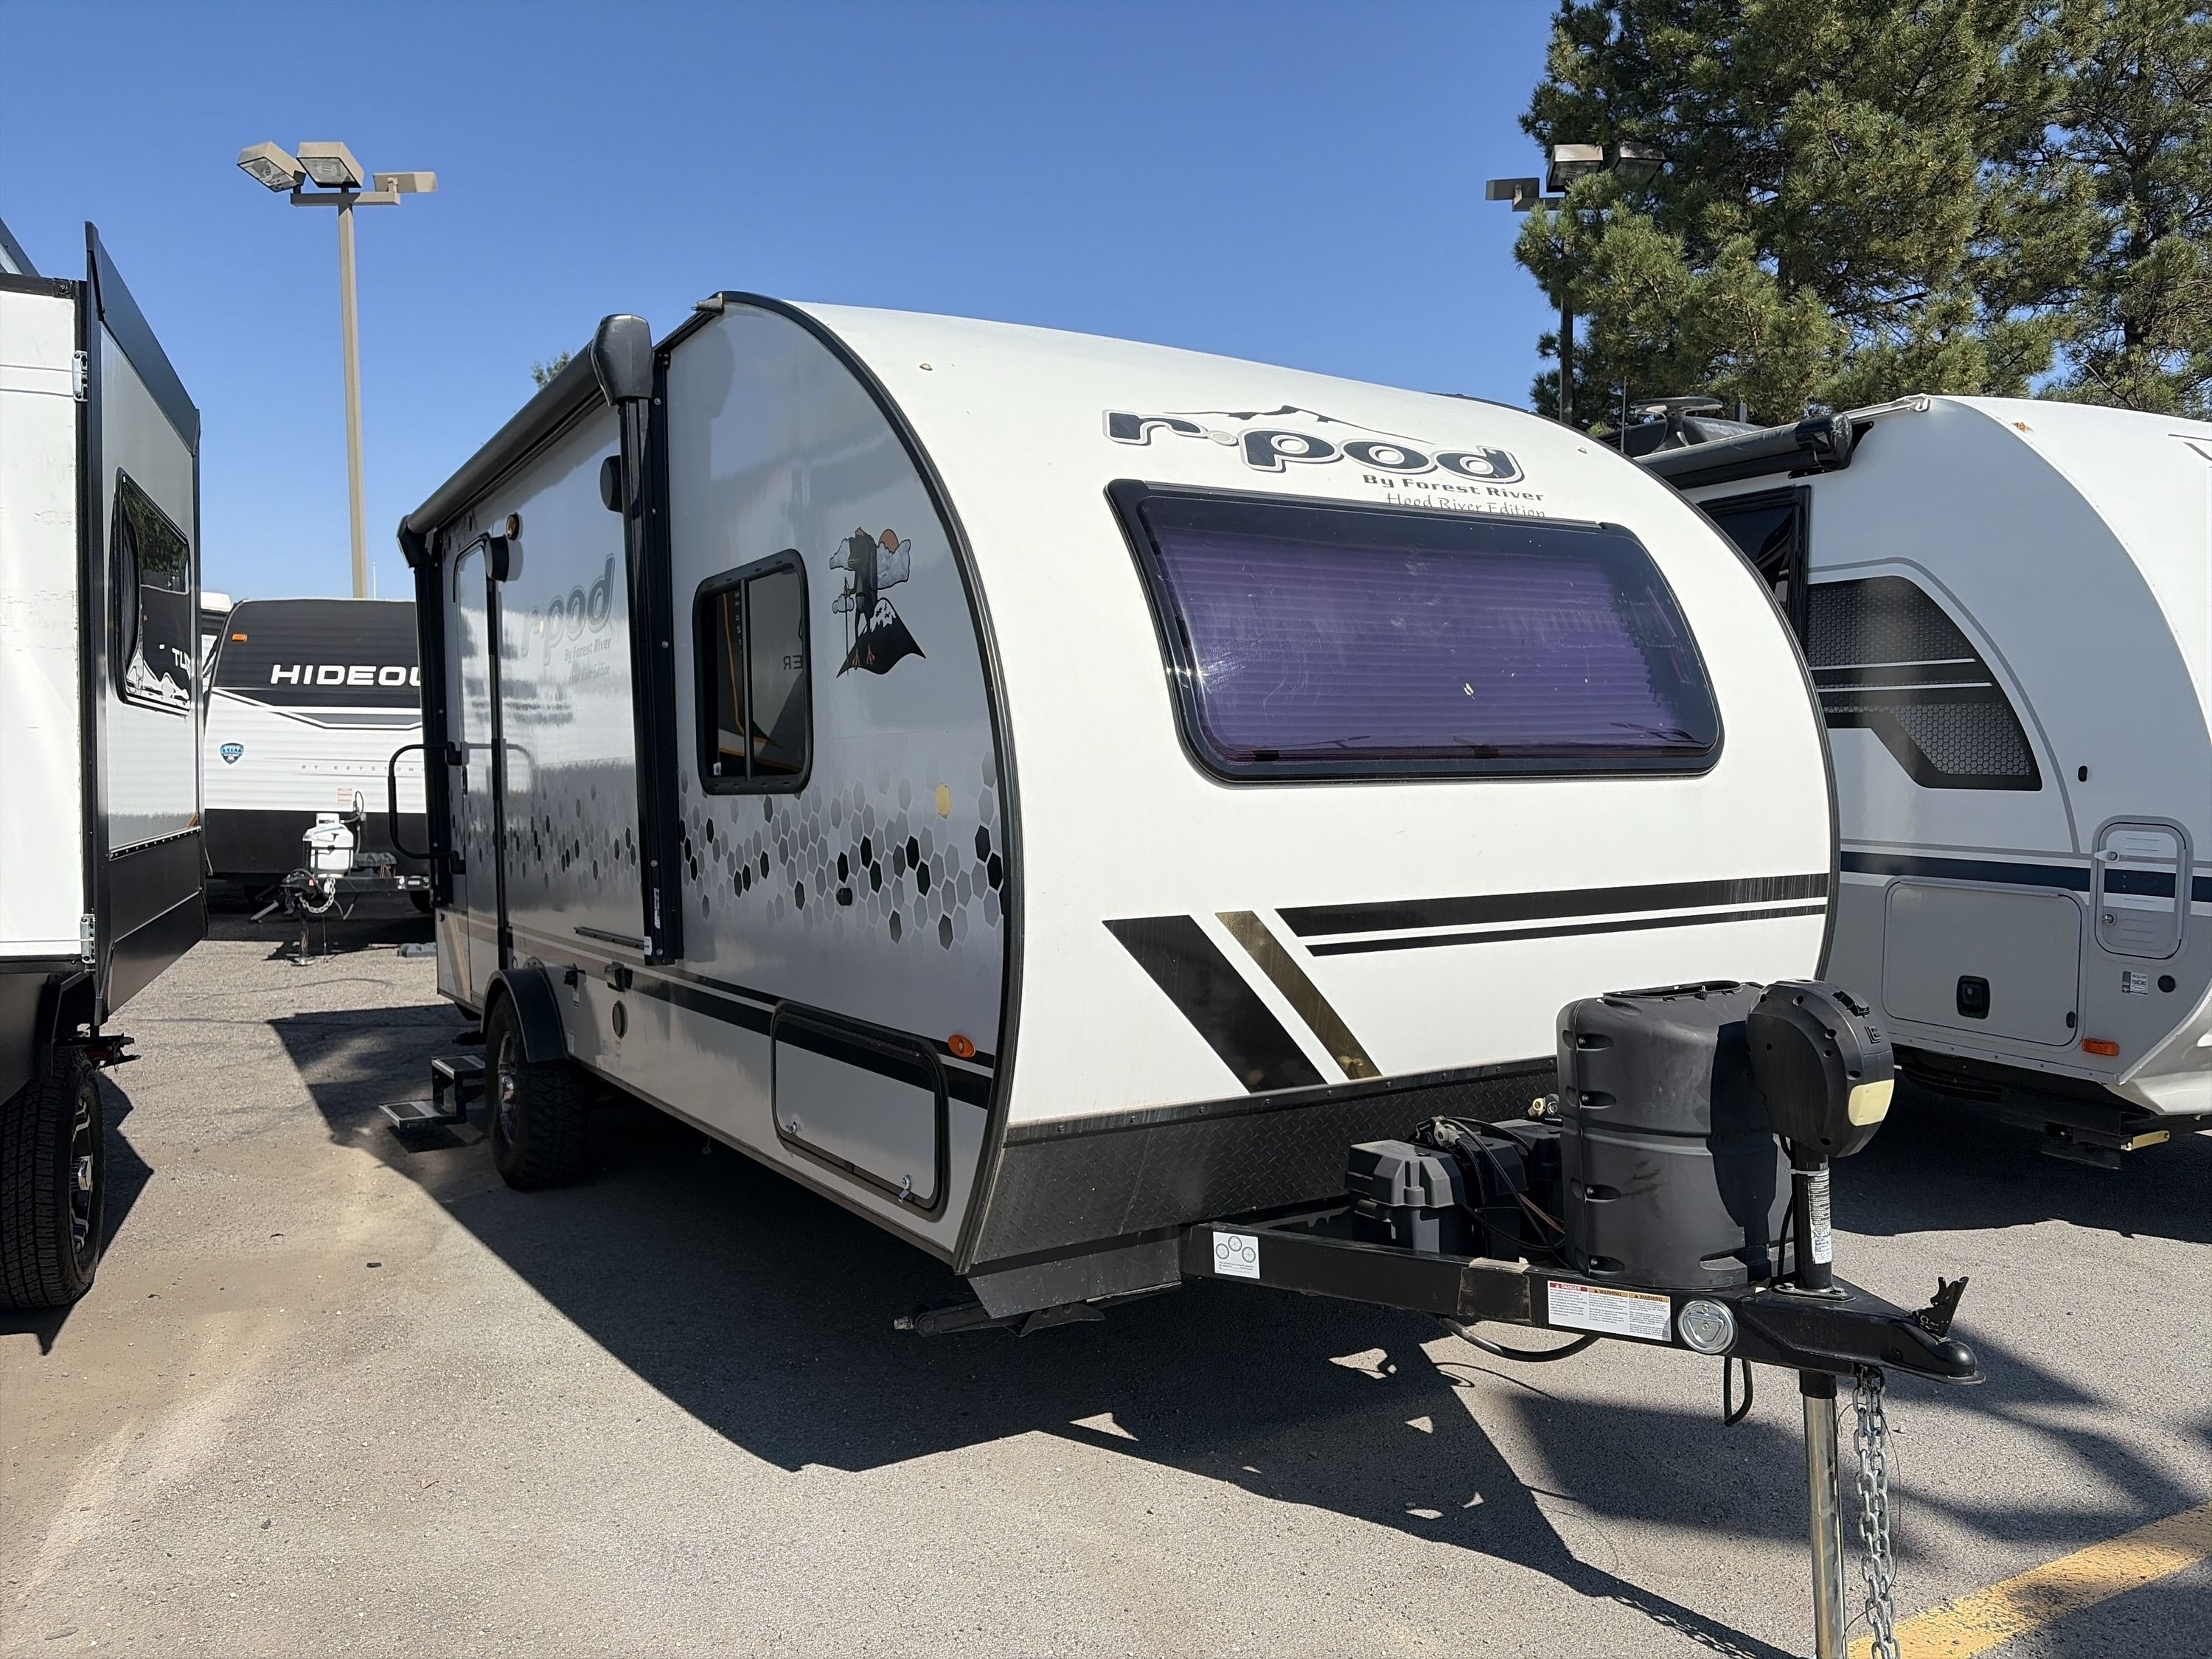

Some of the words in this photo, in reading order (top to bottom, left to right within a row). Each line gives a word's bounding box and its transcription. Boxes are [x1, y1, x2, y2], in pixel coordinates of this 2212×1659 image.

[1363, 474, 1395, 488] By
[1402, 478, 1481, 495] Forest
[1486, 487, 1544, 501] River
[1437, 497, 1483, 513] River
[573, 642, 593, 658] Forest
[594, 637, 611, 653] River
[1599, 1289, 1622, 1297] WARNING
[1639, 1294, 1663, 1302] WARNING
